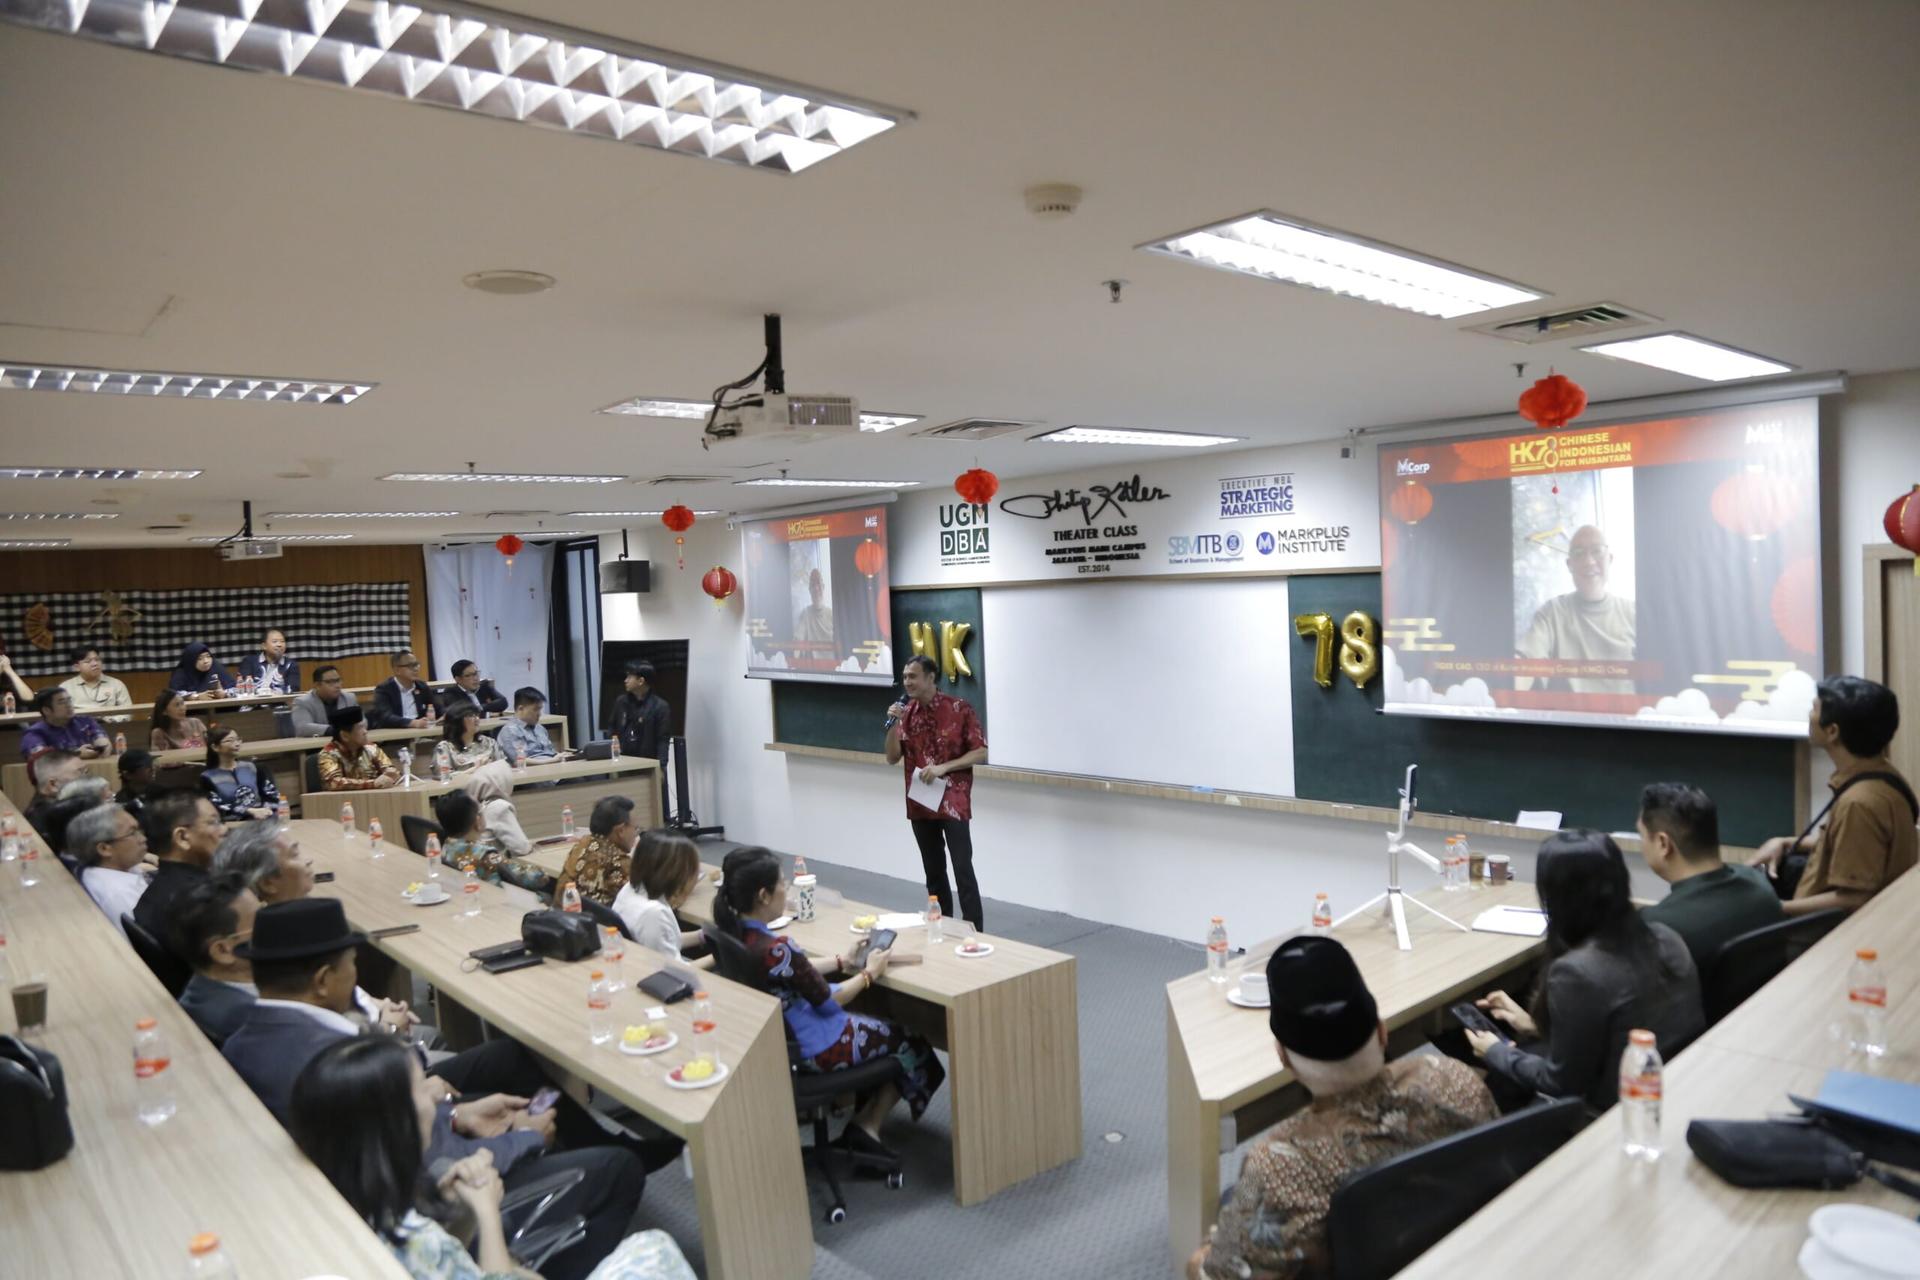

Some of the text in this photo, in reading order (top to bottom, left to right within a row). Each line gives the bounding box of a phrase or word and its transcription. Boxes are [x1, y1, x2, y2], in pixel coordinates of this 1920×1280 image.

[1560, 432, 1609, 446] CHINESE
[1560, 442, 1631, 458] INDONESIAN
[1560, 454, 1632, 467] FOR NUSANTARA
[1221, 475, 1292, 490] EXECUTIVE MBA
[1221, 485, 1293, 505] STRATEGIC
[939, 503, 989, 528] UGM
[1221, 499, 1294, 516] MARKETING
[1053, 525, 1138, 541] THEATER CLASS
[1278, 526, 1350, 541] MARKPLUS
[941, 530, 989, 553] DBA
[1278, 539, 1346, 554] INSTITUTE
